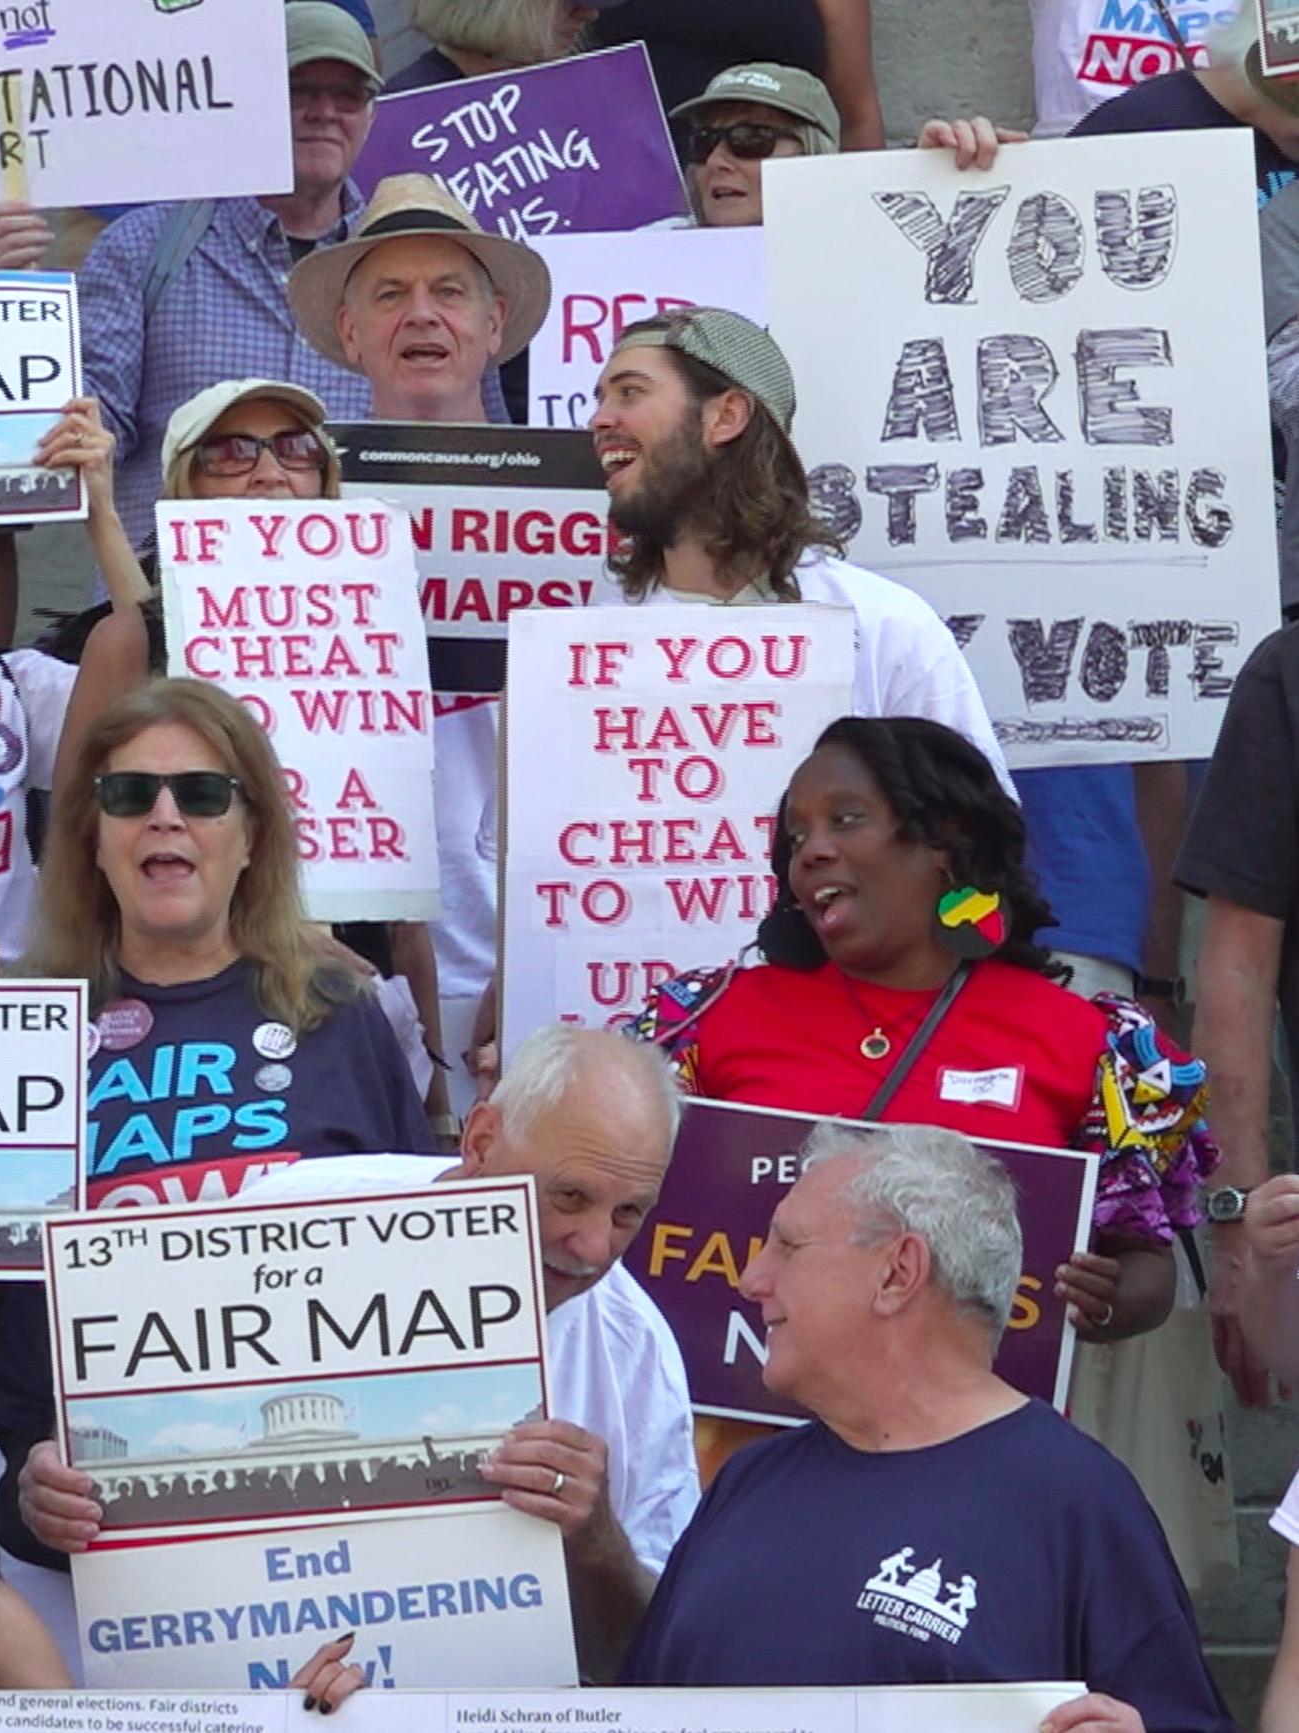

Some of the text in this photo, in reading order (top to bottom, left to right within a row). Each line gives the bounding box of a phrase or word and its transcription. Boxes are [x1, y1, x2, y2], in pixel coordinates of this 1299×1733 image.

[0, 0, 51, 33] not
[1085, 39, 1211, 82] NO
[412, 84, 521, 162] STOP
[432, 128, 600, 214] EATING
[871, 183, 1179, 304] YOU
[880, 328, 1175, 447] ARE
[358, 449, 542, 468] commoncause.org/ohio
[806, 462, 1235, 549] STEALING
[170, 518, 228, 562] IF
[249, 513, 390, 561] YOU
[451, 508, 626, 557] RIGG
[197, 583, 380, 632] MUST
[184, 632, 402, 681] CHEAT
[568, 635, 811, 687] IF YOU
[1007, 614, 1241, 713] VOTE
[290, 690, 428, 736] WIN
[593, 700, 783, 753] HAVE
[335, 767, 383, 814] A
[628, 755, 726, 803] TO
[294, 816, 411, 863] SER
[558, 816, 778, 868] CHEAT
[536, 878, 632, 928] TO
[87, 1041, 237, 1112] AIR
[63, 1203, 519, 1270] 13TH DISTRICT VOTER
[253, 1263, 323, 1295] for a
[71, 1284, 523, 1382] FAIR MAP
[264, 1540, 352, 1582] End
[87, 1572, 543, 1655] GERRYMANDERING
[856, 1591, 962, 1645] LETTER CARRIER
[247, 1645, 396, 1690] N!
[5, 1713, 85, 1729] candidates
[88, 1716, 103, 1729] to
[106, 1716, 124, 1731] be
[127, 1718, 202, 1733] successful
[19, 1694, 73, 1711] general
[76, 1695, 146, 1712] elections.
[150, 1698, 177, 1712] Fair
[180, 1699, 239, 1715] districts
[457, 1707, 622, 1723] Heidi Schran of Butler
